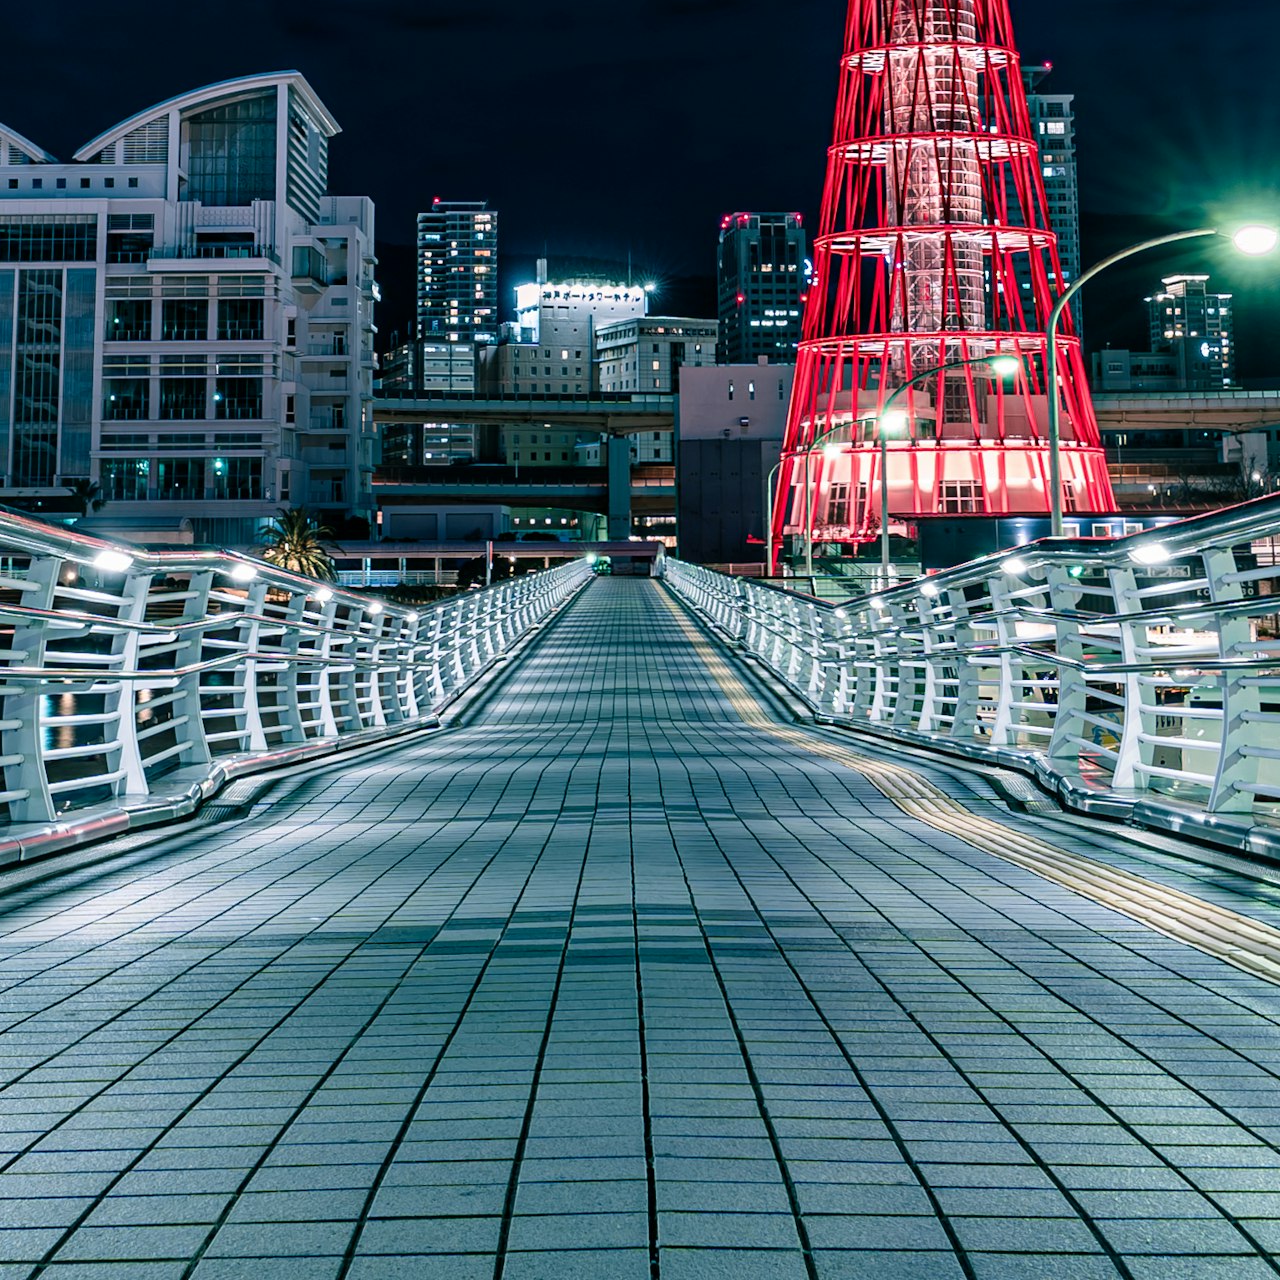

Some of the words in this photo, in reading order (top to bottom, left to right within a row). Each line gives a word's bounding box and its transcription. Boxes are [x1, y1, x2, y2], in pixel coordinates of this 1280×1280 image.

[542, 290, 641, 302] 神戸ポートタワーホテル
